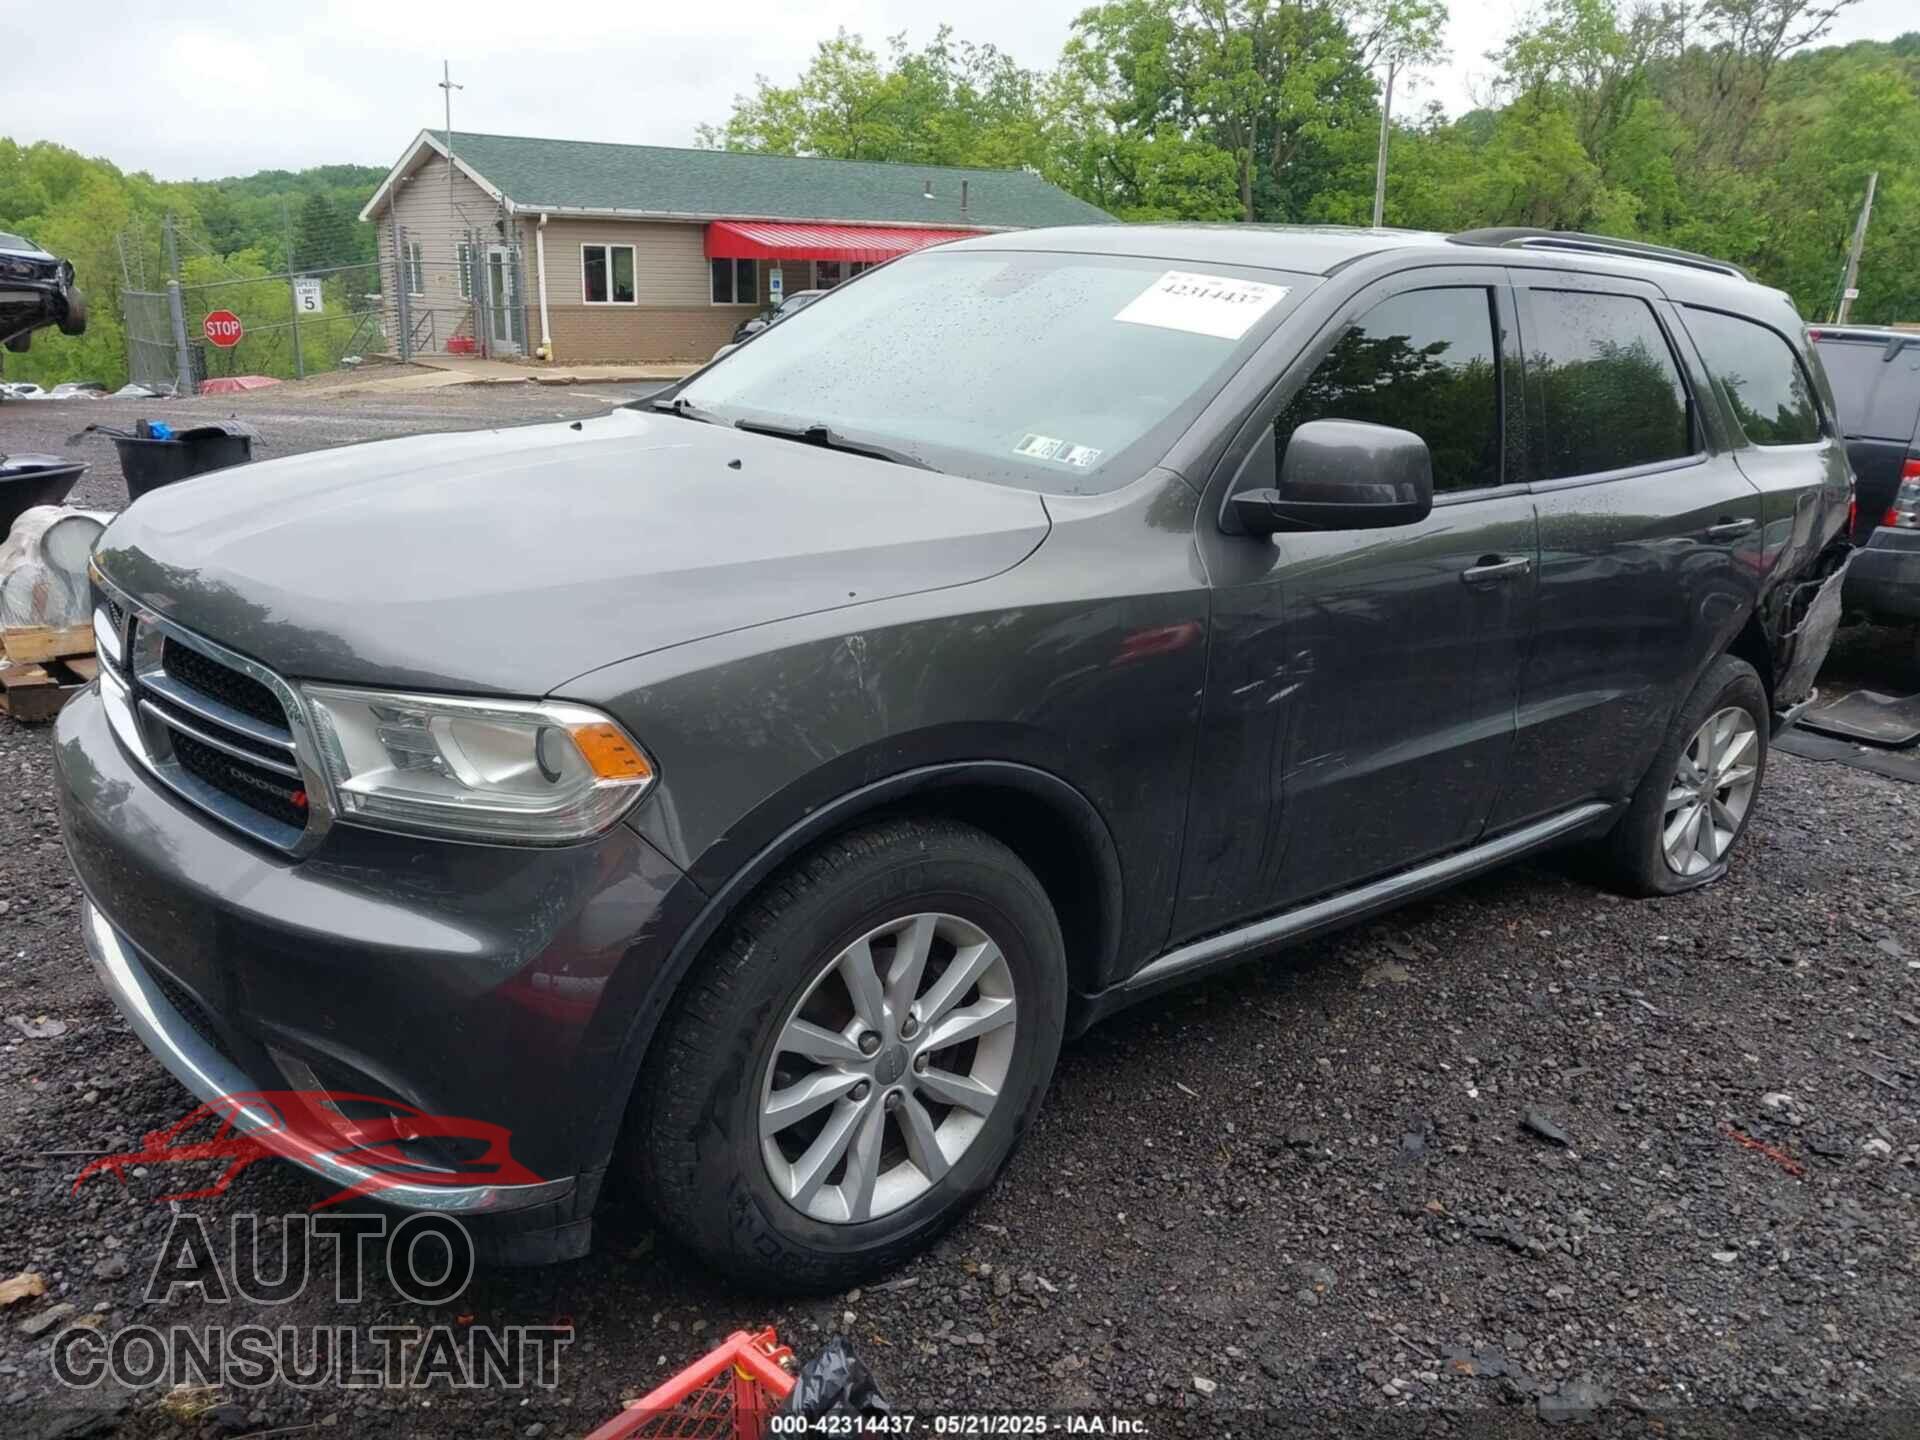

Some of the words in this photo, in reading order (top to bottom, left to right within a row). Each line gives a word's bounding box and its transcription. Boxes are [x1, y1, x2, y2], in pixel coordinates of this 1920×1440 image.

[298, 287, 318, 296] LIMIT
[304, 296, 315, 310] 5
[206, 321, 239, 336] STOP
